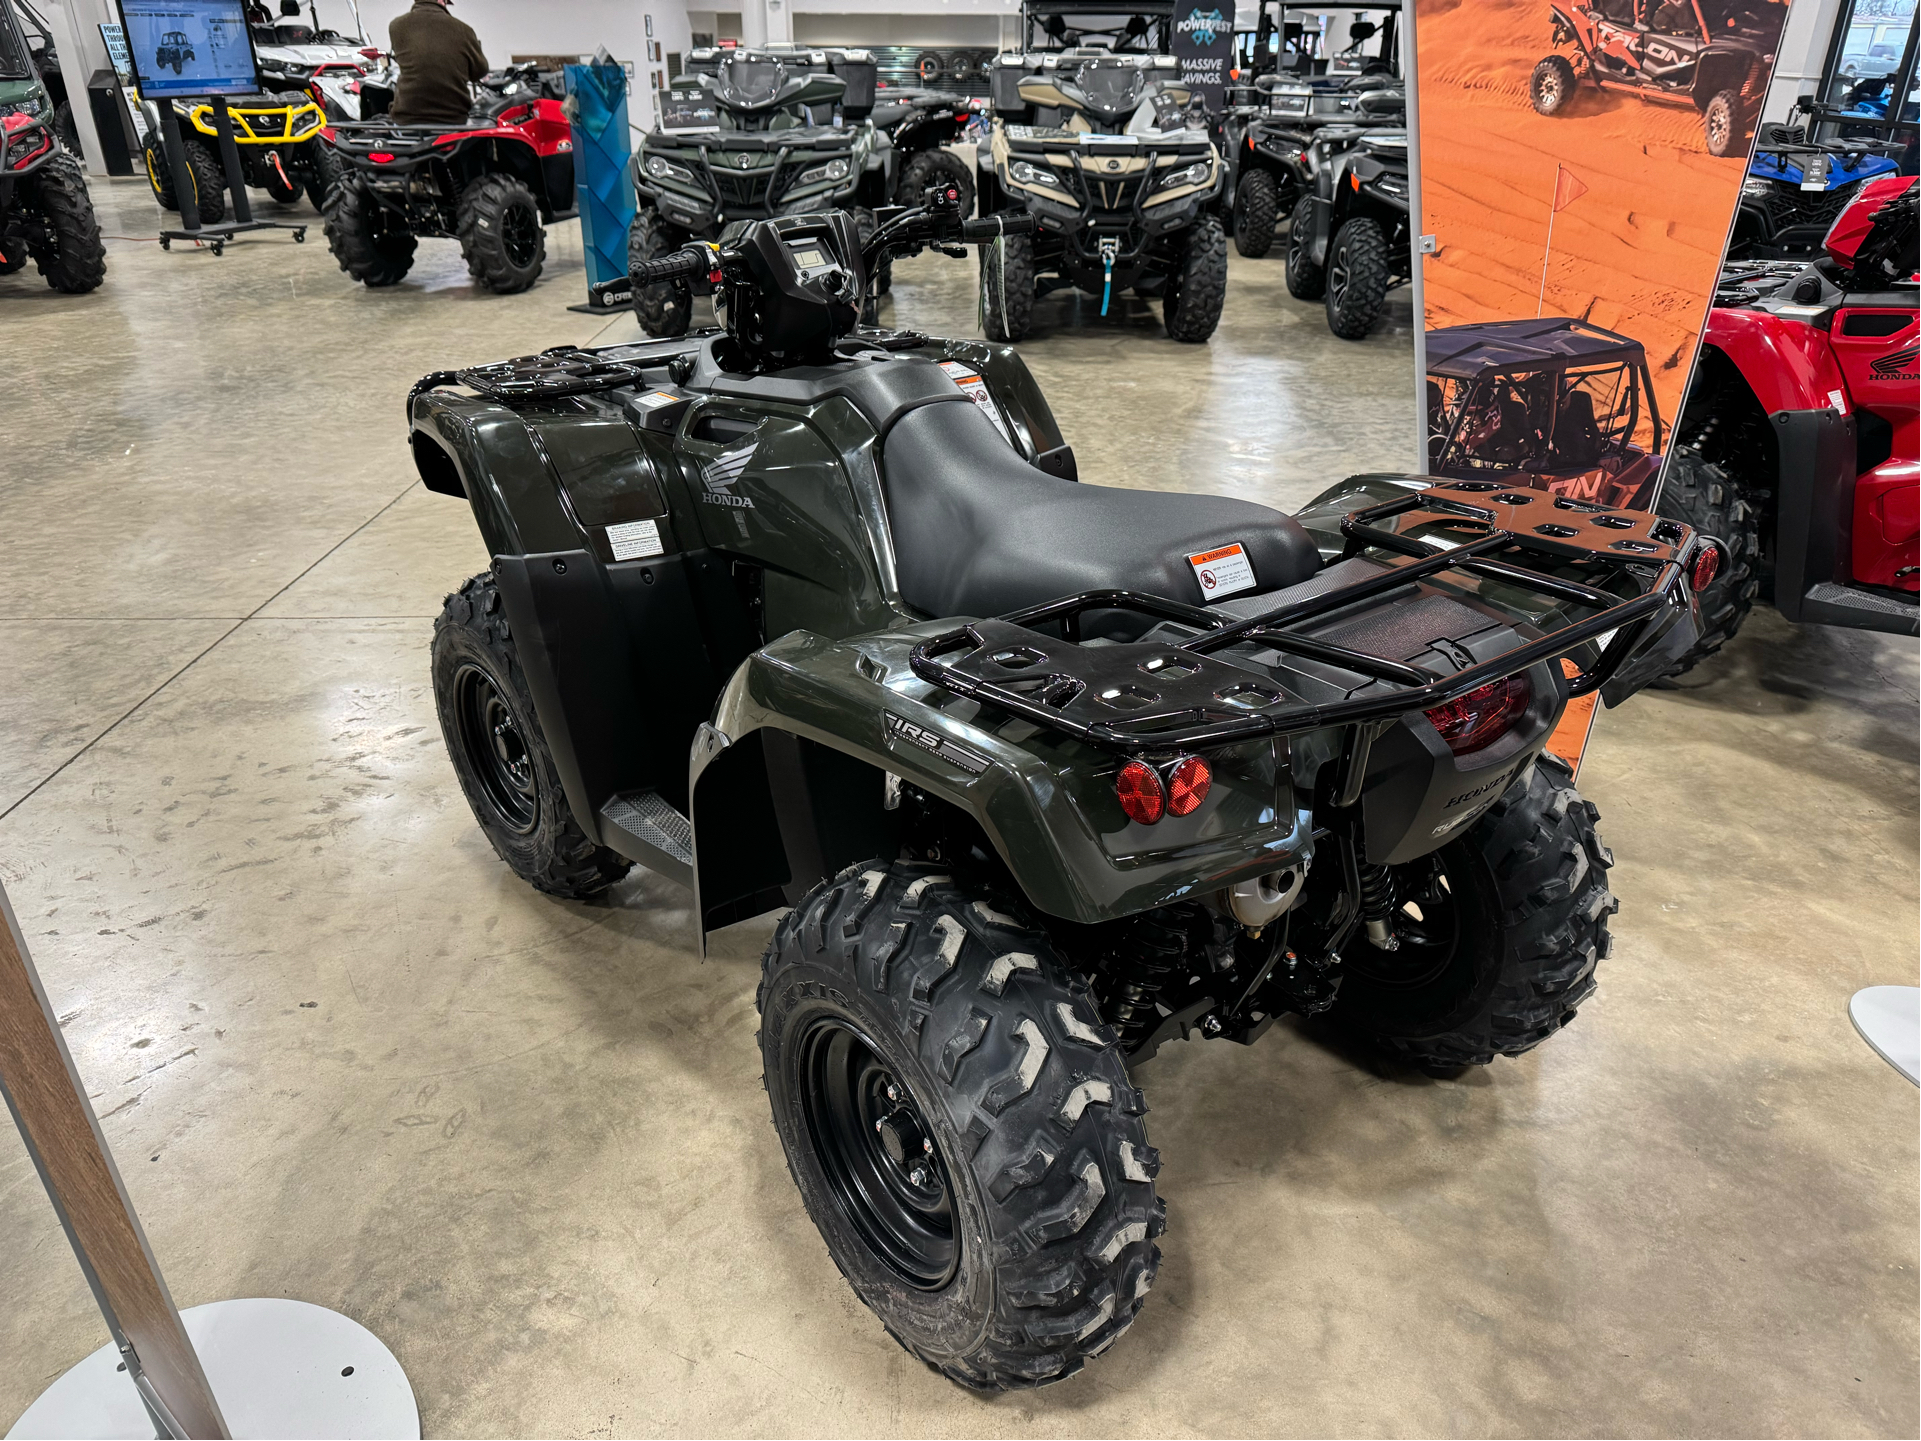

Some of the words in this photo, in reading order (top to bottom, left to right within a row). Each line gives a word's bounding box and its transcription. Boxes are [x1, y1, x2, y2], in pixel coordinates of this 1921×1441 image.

[1177, 13, 1232, 35] POWERFEST
[1181, 58, 1223, 71] MASSIVE
[1868, 373, 1921, 381] HONDA
[702, 492, 756, 509] HONDA
[1207, 549, 1232, 560] WARNING
[895, 719, 940, 747] IRS
